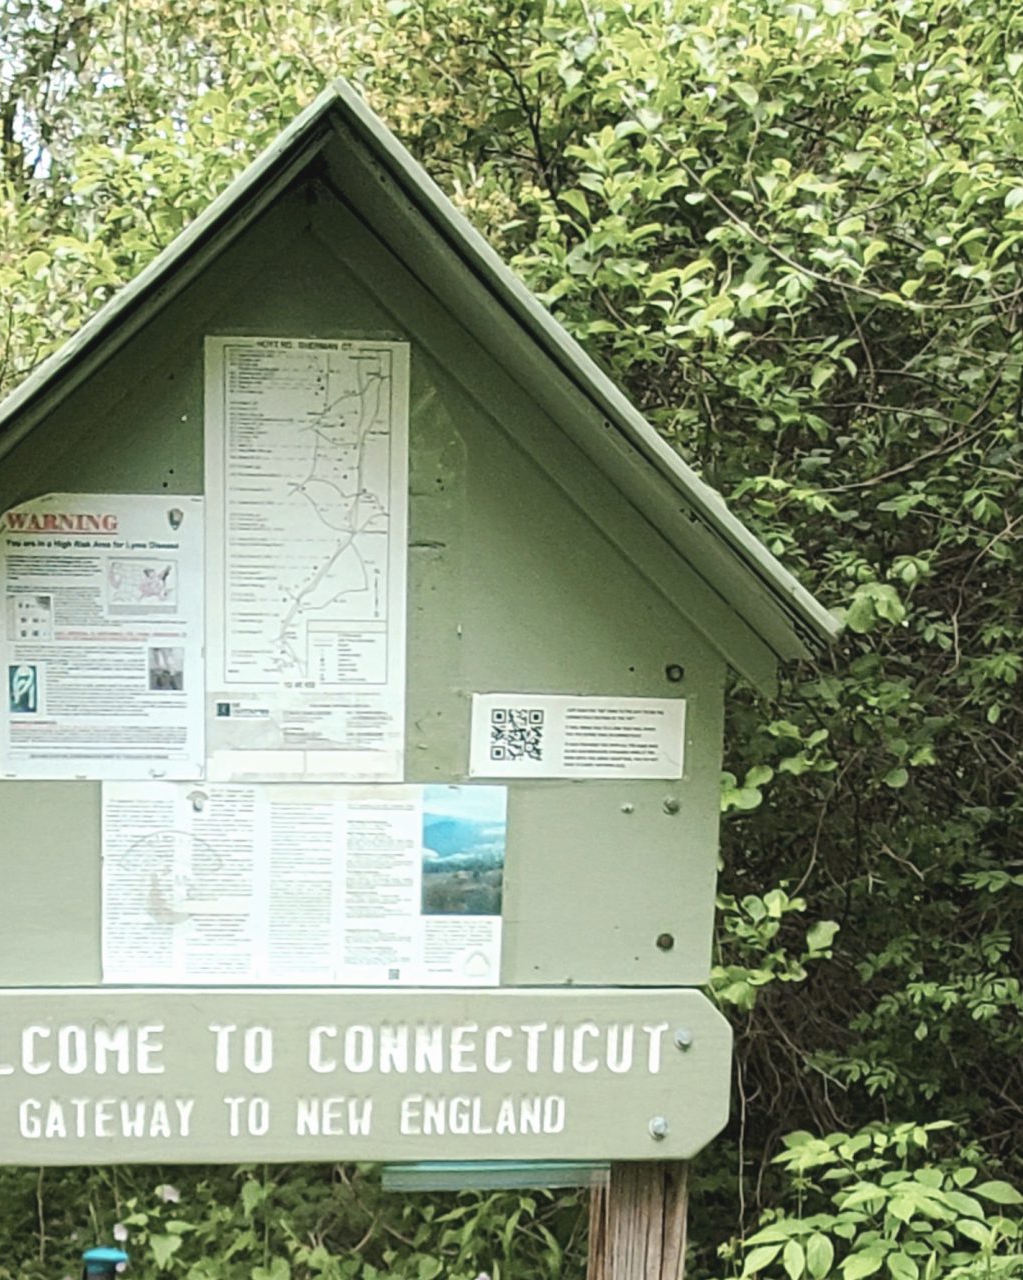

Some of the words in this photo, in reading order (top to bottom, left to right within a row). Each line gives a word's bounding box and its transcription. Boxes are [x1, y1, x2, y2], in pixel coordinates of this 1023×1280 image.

[7, 512, 118, 532] WARNING
[6, 539, 21, 547] You
[54, 540, 72, 549] High
[125, 541, 147, 550] Lyme
[209, 1024, 273, 1074] TO
[308, 1022, 669, 1074] CONNECTICUT
[19, 1097, 195, 1138] GATEWAY
[224, 1097, 270, 1137] TO
[296, 1096, 373, 1136] NEW
[400, 1095, 566, 1135] ENGLAND
